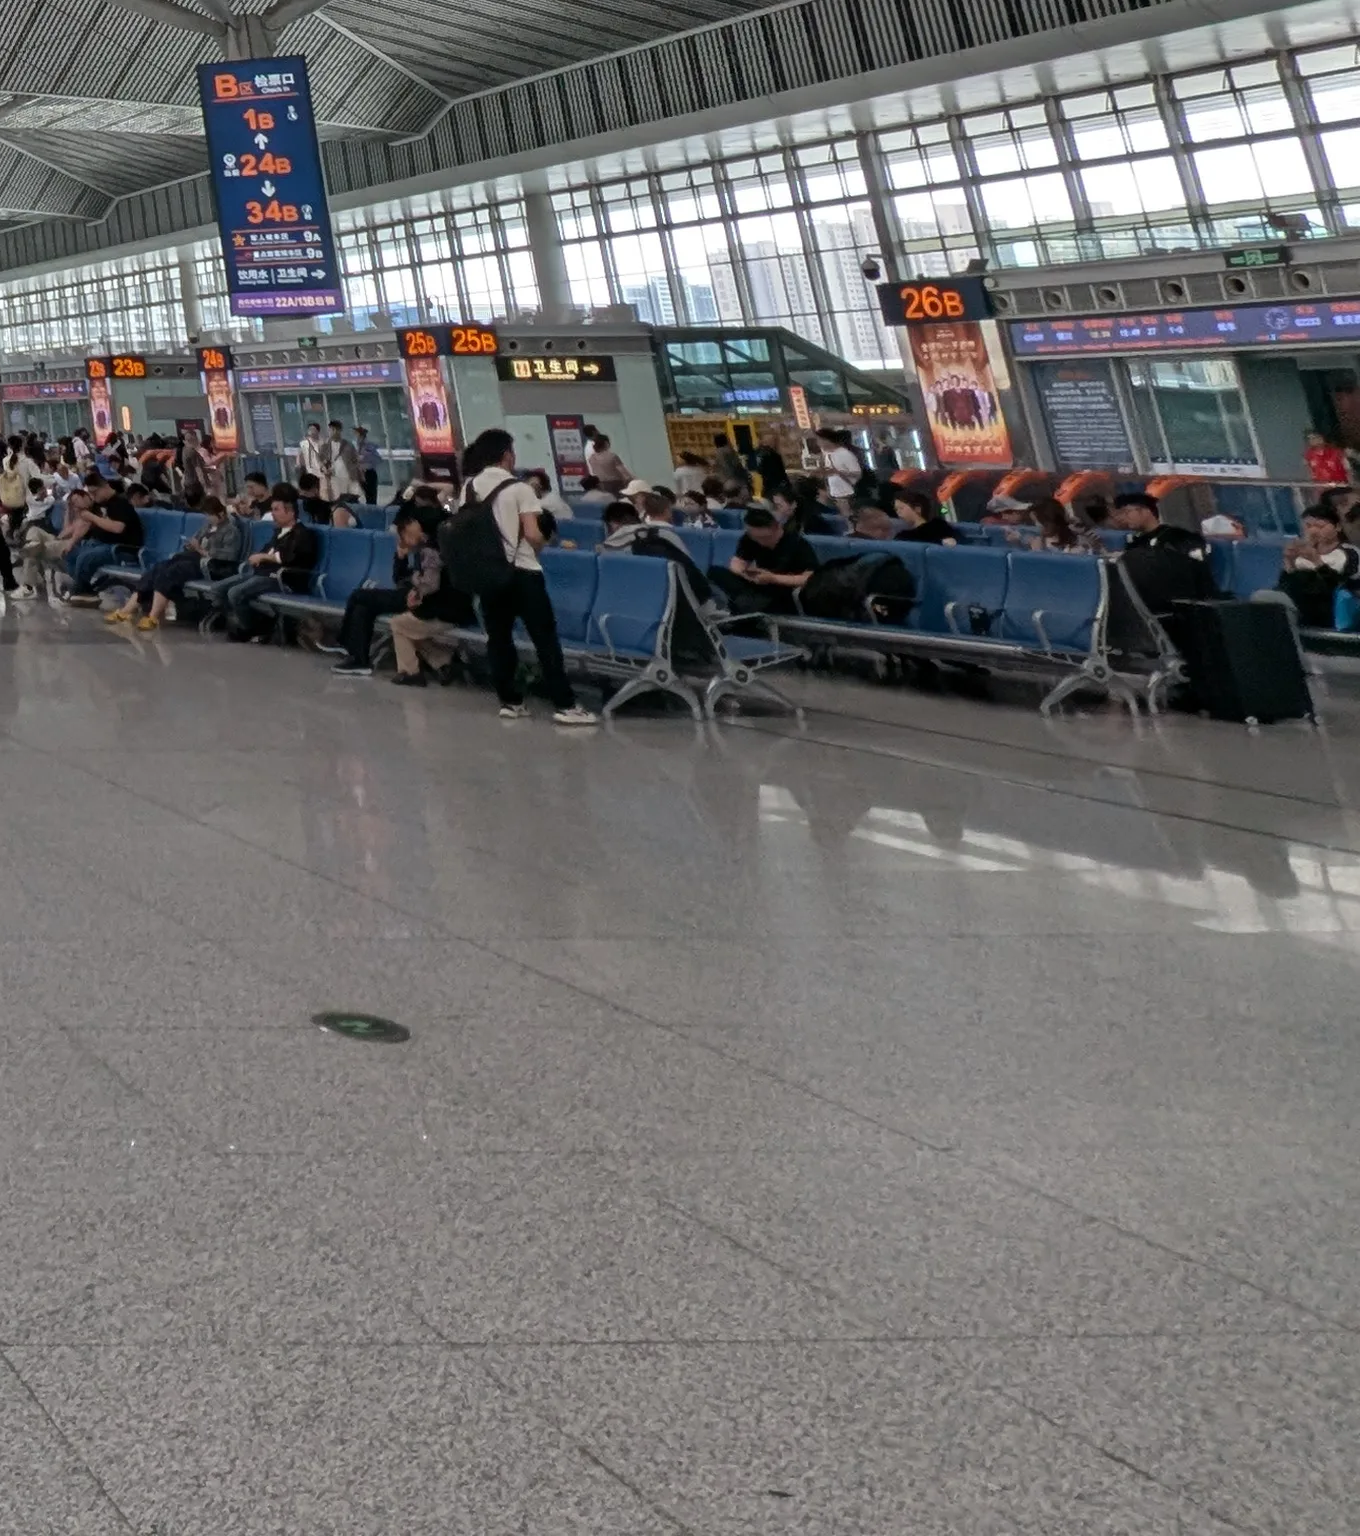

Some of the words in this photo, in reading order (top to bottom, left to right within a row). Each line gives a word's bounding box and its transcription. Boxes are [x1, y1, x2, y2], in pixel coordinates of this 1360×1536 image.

[243, 108, 275, 130] 1B
[240, 153, 292, 176] 24B
[246, 200, 299, 224] 34B
[303, 231, 322, 243] 9A
[277, 267, 308, 279] 卫生间
[900, 286, 964, 319] 26B
[406, 332, 437, 355] 25B
[452, 329, 497, 352] 25B
[112, 358, 145, 377] 23B
[533, 358, 580, 374] 卫生间
